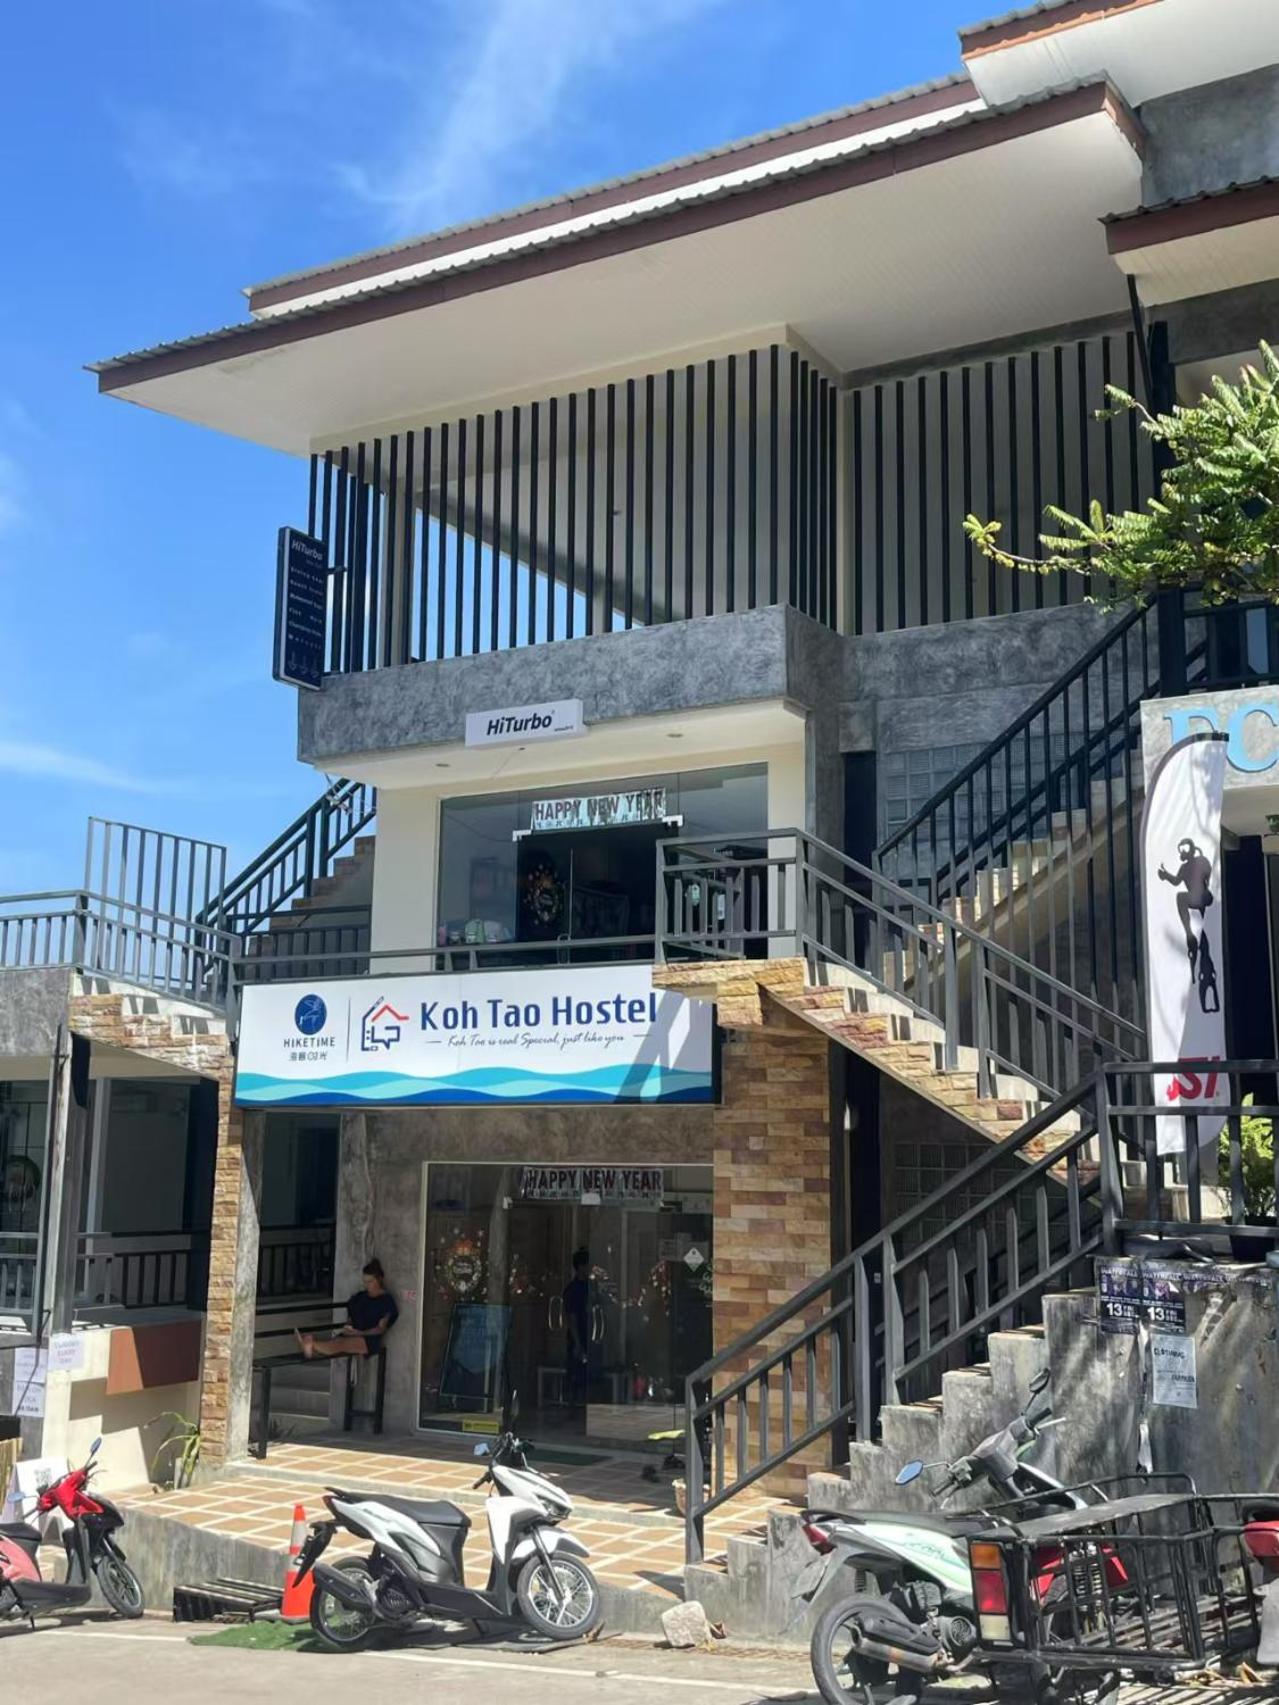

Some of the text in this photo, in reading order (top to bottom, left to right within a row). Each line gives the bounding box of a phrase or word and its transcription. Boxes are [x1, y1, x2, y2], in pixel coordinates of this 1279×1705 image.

[486, 712, 552, 736] HiTurbo
[535, 790, 664, 820] HAPPY NEW YEAR
[421, 992, 657, 1030] Koh Tao Hostel
[283, 1037, 336, 1048] HIKETIME
[448, 1034, 467, 1047] Koh
[470, 1034, 485, 1047] Tao
[529, 1170, 661, 1190] HAPPY NEW YEAR
[1106, 1302, 1123, 1316] 13
[1147, 1307, 1165, 1321] 13
